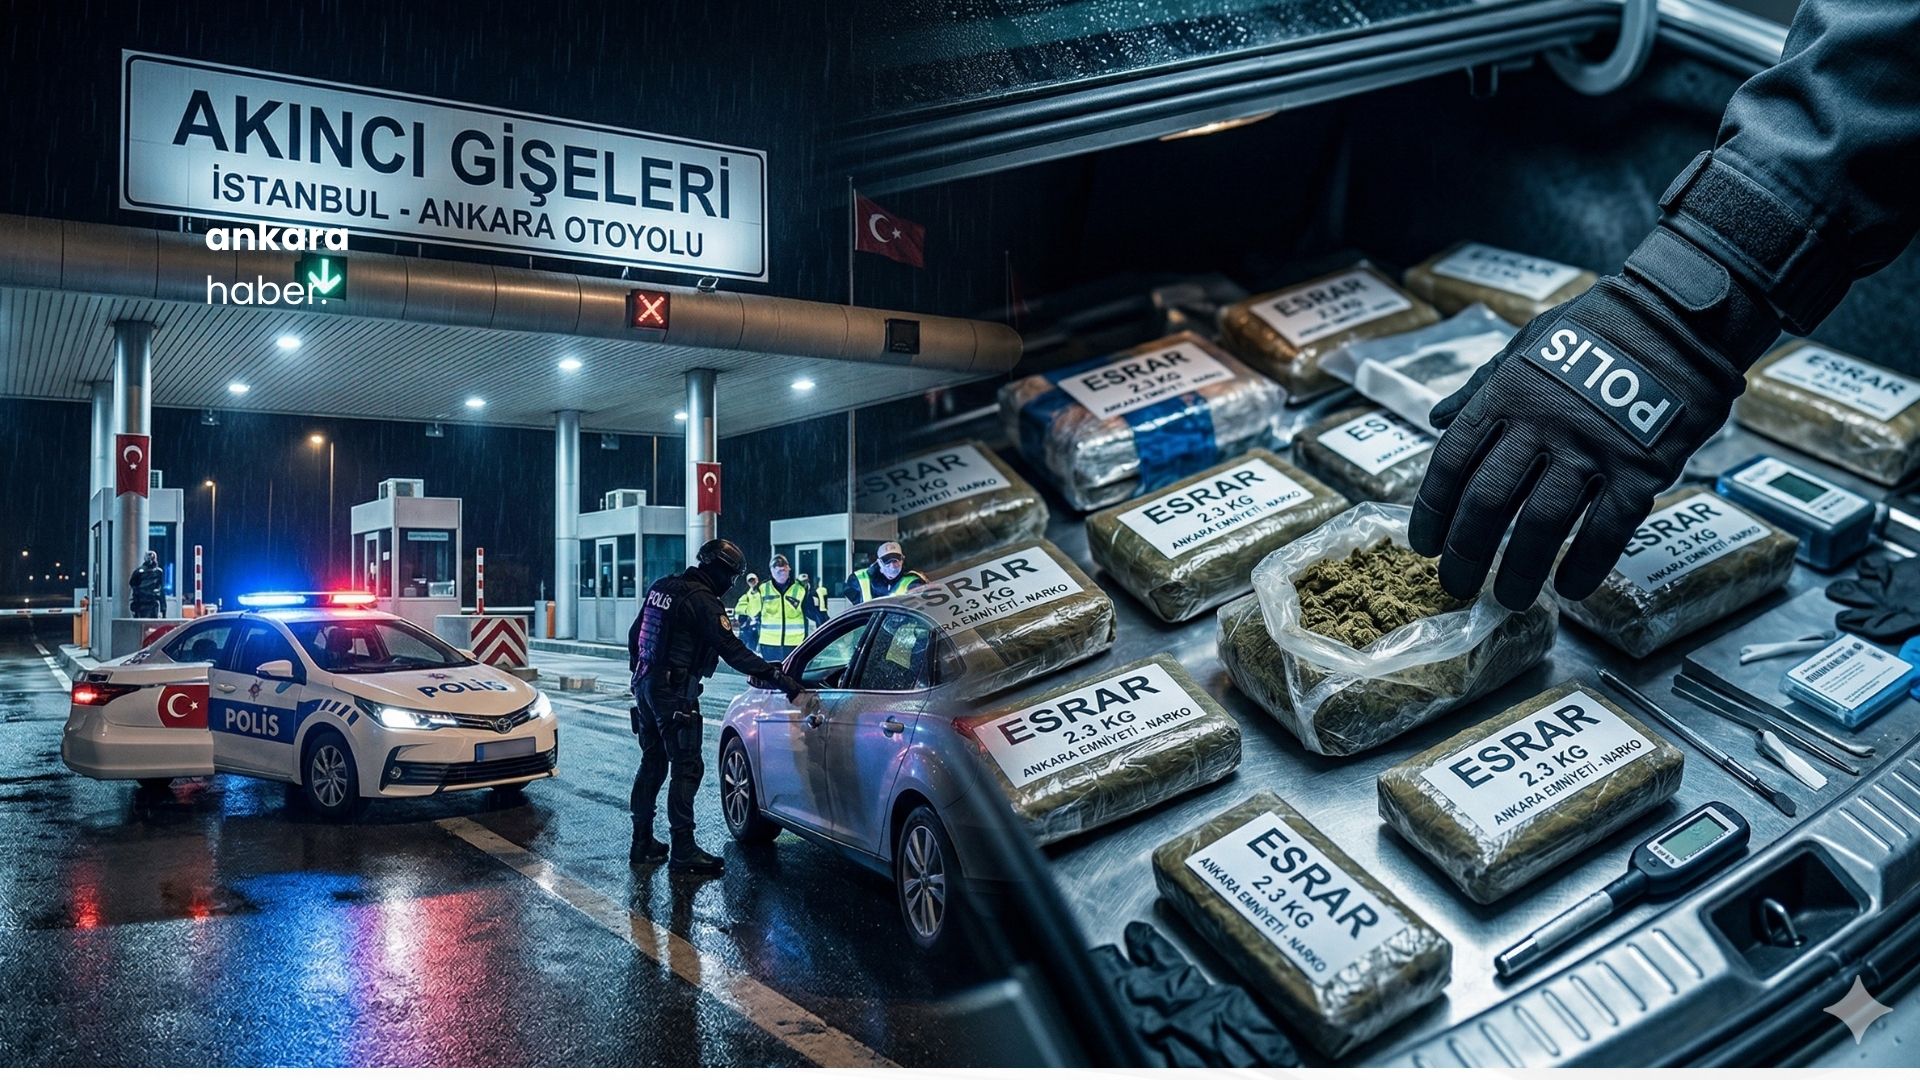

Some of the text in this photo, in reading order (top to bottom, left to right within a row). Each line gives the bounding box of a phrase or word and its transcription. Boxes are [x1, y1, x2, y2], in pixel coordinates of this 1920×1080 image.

[172, 89, 730, 220] AKINCI GİŞELERİ
[213, 163, 389, 220] İSTANBUL
[418, 198, 556, 240] ANKARA
[565, 215, 703, 258] OTOYOLU
[1081, 350, 1192, 392] ESRAR
[1540, 329, 1671, 434] POLİS
[887, 478, 949, 504] 2.3 KG
[1143, 469, 1265, 525] ESRAR
[1196, 494, 1254, 524] 2.3 KG
[1171, 526, 1217, 550] ANKARA
[1624, 502, 1723, 558] ESRAR
[1665, 528, 1718, 557] 2.3 KG
[1646, 561, 1690, 584] ANKARA
[646, 590, 673, 610] POLİS
[948, 586, 1015, 617] 2.3 KG
[962, 598, 1019, 625] EMNİYETİ
[1025, 583, 1069, 602] NARKO
[417, 678, 510, 698] POLİS
[225, 706, 280, 737] POLİS
[997, 675, 1161, 746] ESRAR
[1062, 709, 1136, 745] 2.3 KG
[1022, 750, 1079, 778] ANKARA
[1079, 726, 1140, 755] EMNİYETİ
[1145, 706, 1192, 731] NARKO
[1449, 703, 1601, 790] ESRAR
[1492, 792, 1547, 826] ANKARA
[1545, 761, 1598, 798] EMNİYETİ
[1602, 739, 1642, 766] NARKO
[1518, 744, 1589, 788] 2.3 KG
[1246, 827, 1380, 940] ESRAR
[1252, 875, 1315, 929] 2.3 KG
[1198, 857, 1240, 895] ANKARA
[1236, 890, 1289, 935] EMNİYETİ
[1287, 937, 1327, 973] NARKO
